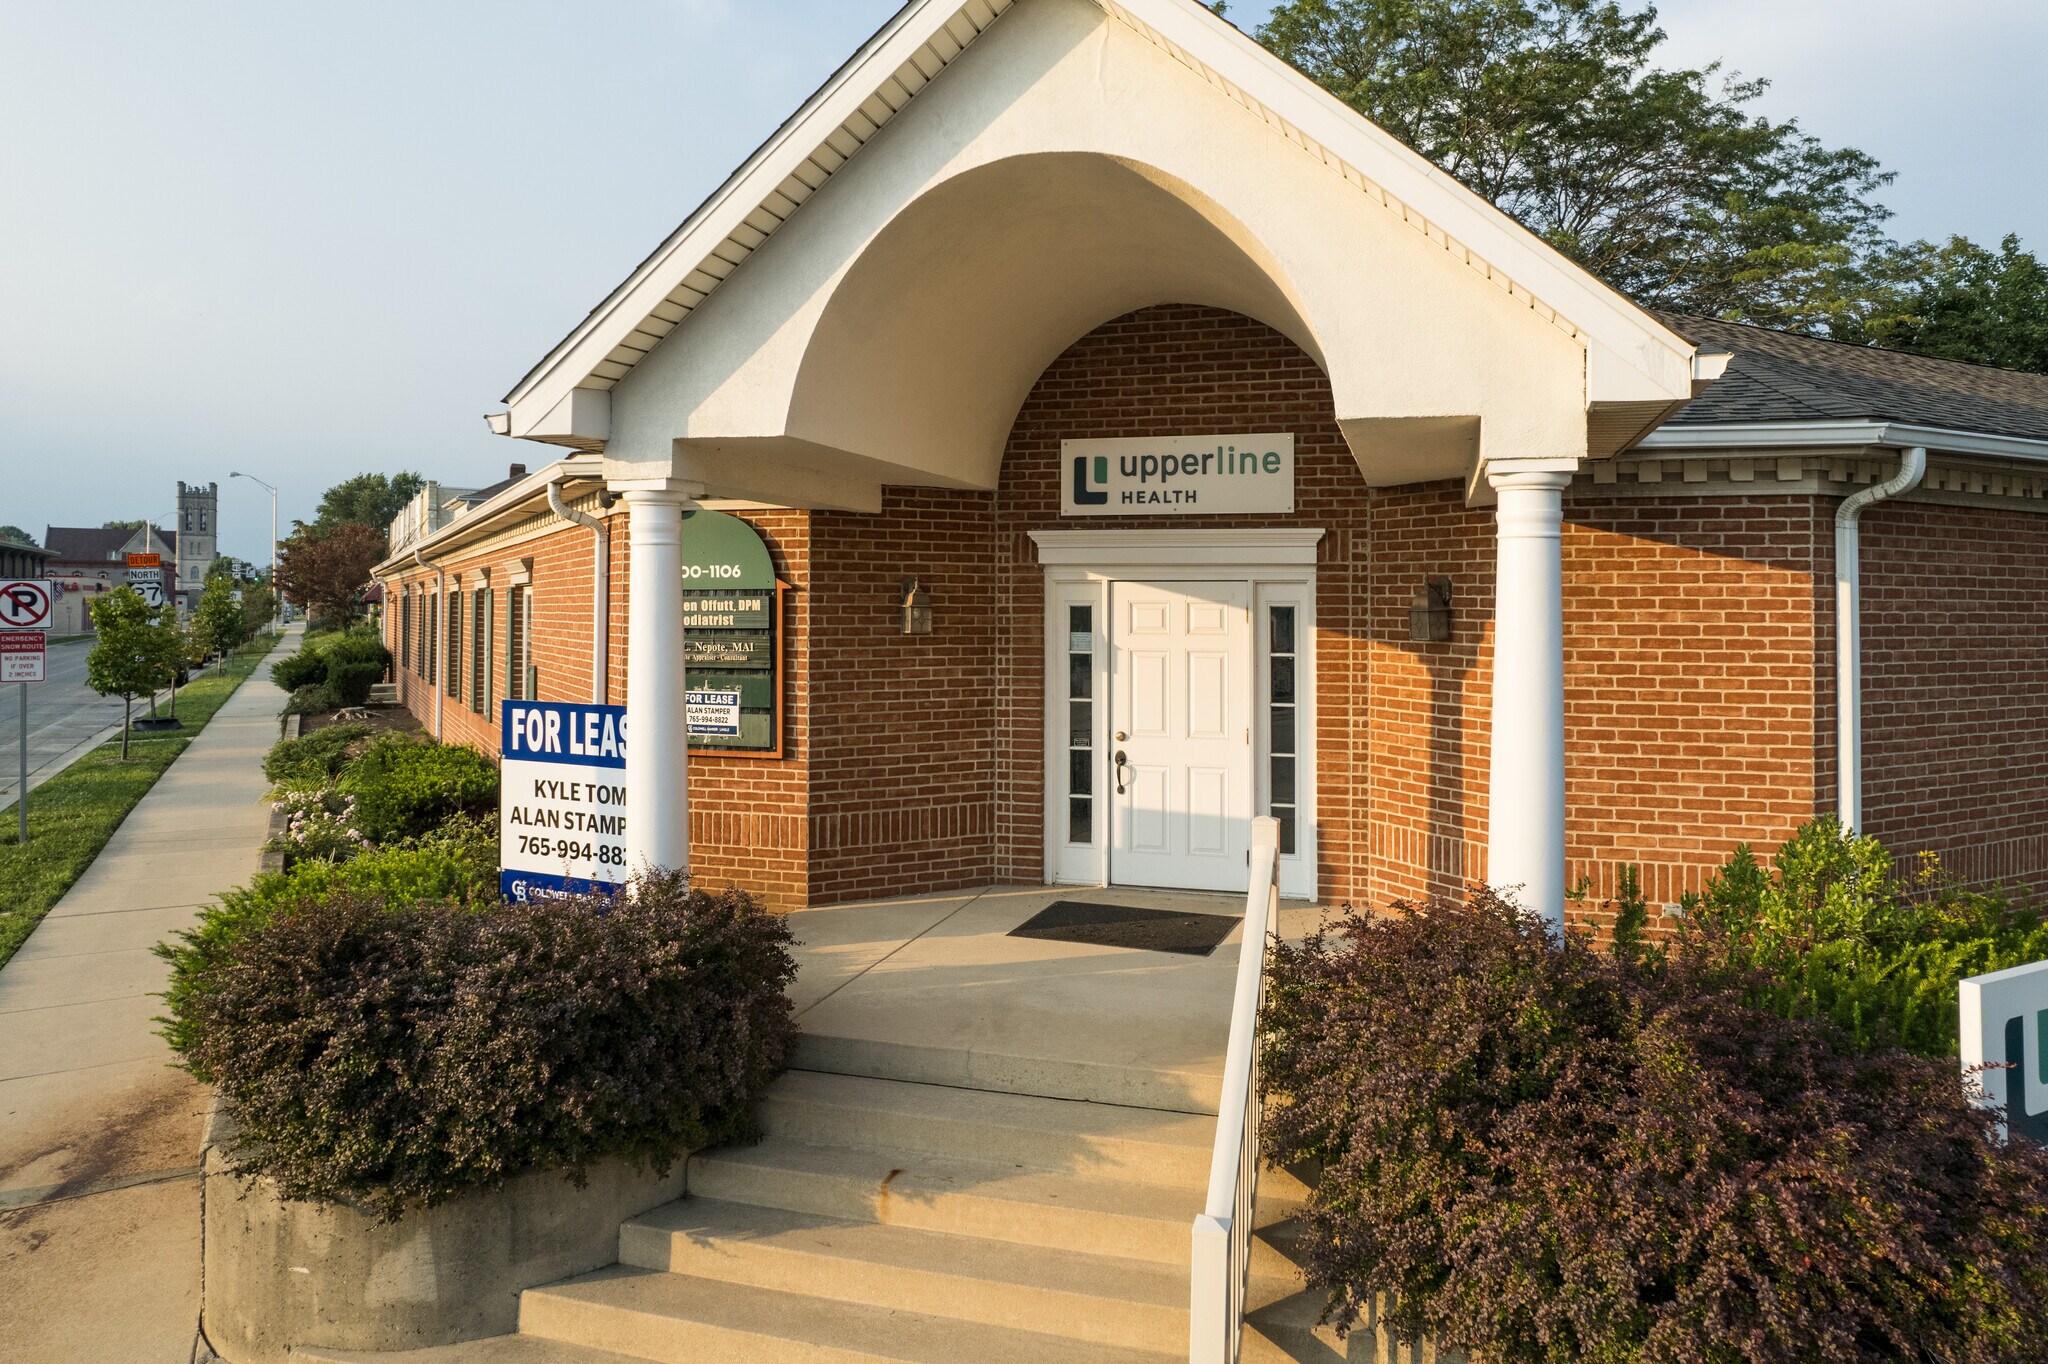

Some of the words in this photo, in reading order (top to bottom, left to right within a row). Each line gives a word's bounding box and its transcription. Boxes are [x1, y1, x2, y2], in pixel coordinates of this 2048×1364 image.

[1120, 446, 1281, 484] upperline
[1121, 490, 1197, 504] HEALTH
[130, 557, 158, 565] DETOUR
[130, 570, 159, 579] NORTH
[701, 599, 737, 612] Offutt,
[738, 599, 761, 611] DPM
[683, 614, 734, 626] odiatrist
[694, 641, 728, 654] Nepote,
[732, 642, 754, 652] MAI
[686, 693, 703, 704] FOR
[704, 694, 734, 705] LEASE
[704, 707, 731, 715] STAMPER
[689, 715, 729, 723] 765-994-8822
[511, 708, 562, 754] FOR
[534, 779, 581, 801] KYLE
[510, 806, 560, 829] ALAN
[518, 835, 626, 867] 765-994-88
